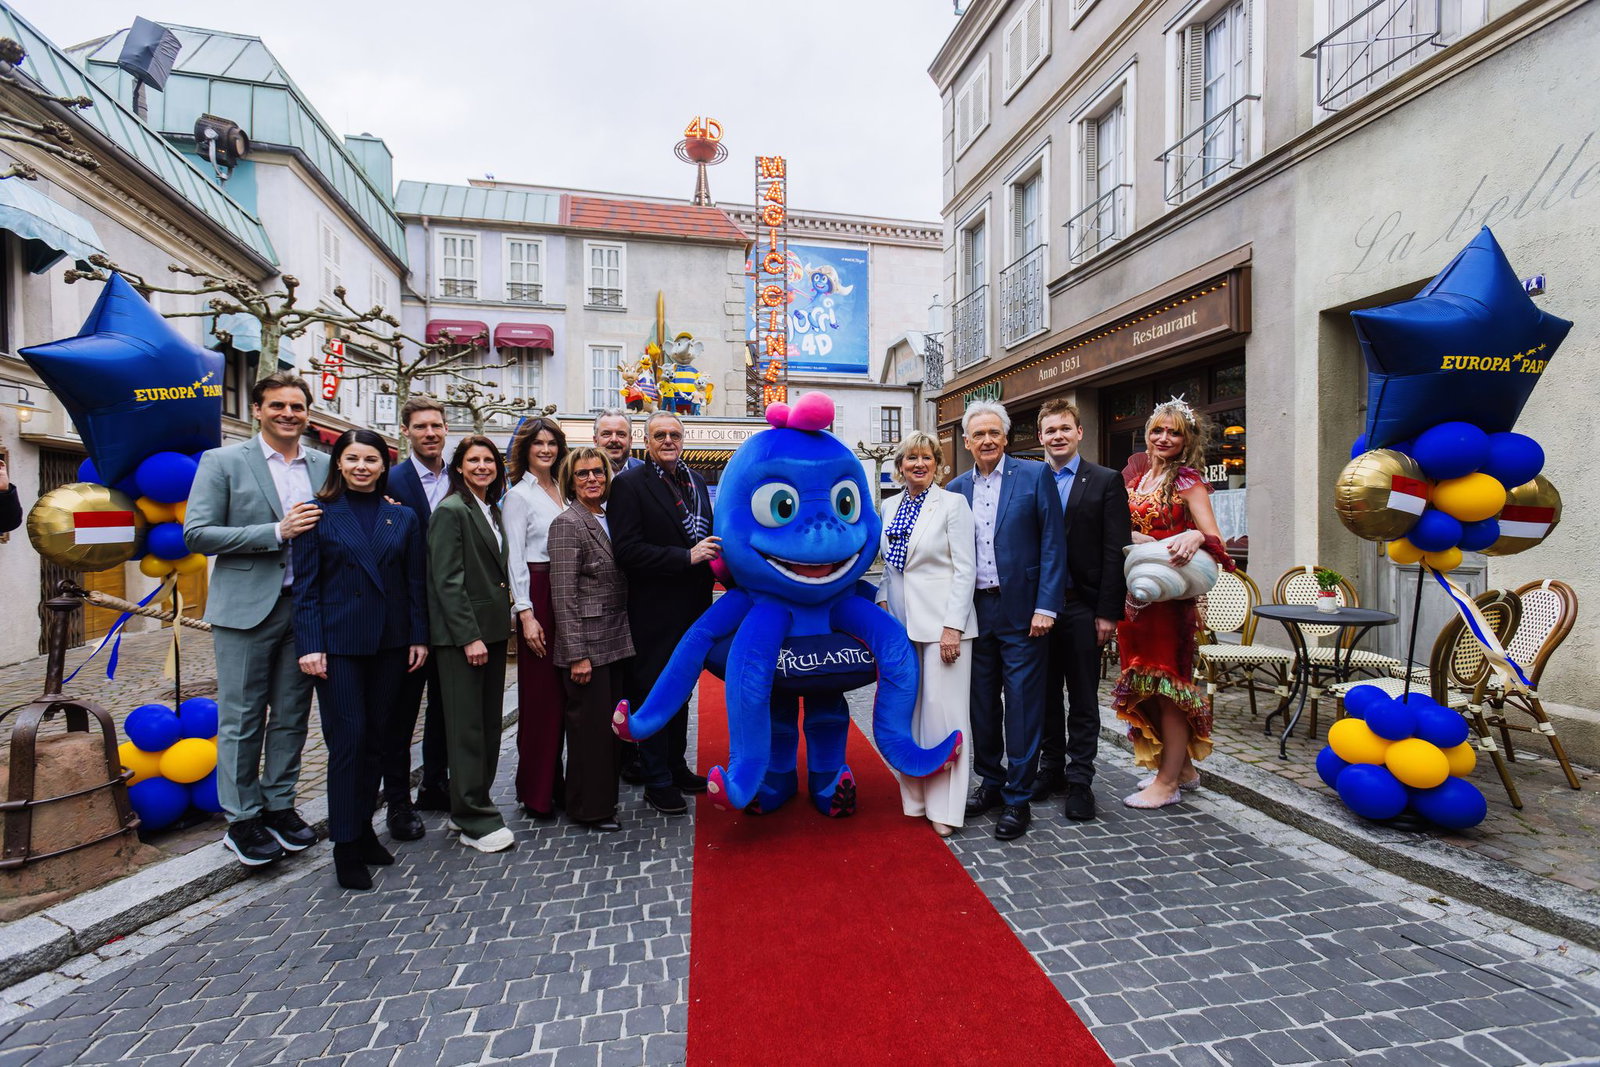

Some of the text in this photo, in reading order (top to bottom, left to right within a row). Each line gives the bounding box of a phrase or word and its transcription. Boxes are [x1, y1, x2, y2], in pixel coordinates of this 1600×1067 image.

[684, 115, 724, 142] 4D
[760, 155, 785, 275] MAGIC
[1325, 210, 1416, 285] La
[1132, 309, 1198, 347] Restaurant
[761, 284, 787, 408] CINEM
[801, 333, 833, 357] 4D
[1039, 355, 1081, 382] Anno 1931
[1440, 355, 1511, 372] EUROPA
[134, 386, 197, 402] EUROPA
[632, 428, 643, 439] 4D
[697, 429, 704, 439] IF
[707, 429, 725, 440] YOU
[786, 648, 875, 671] RULANTIC
